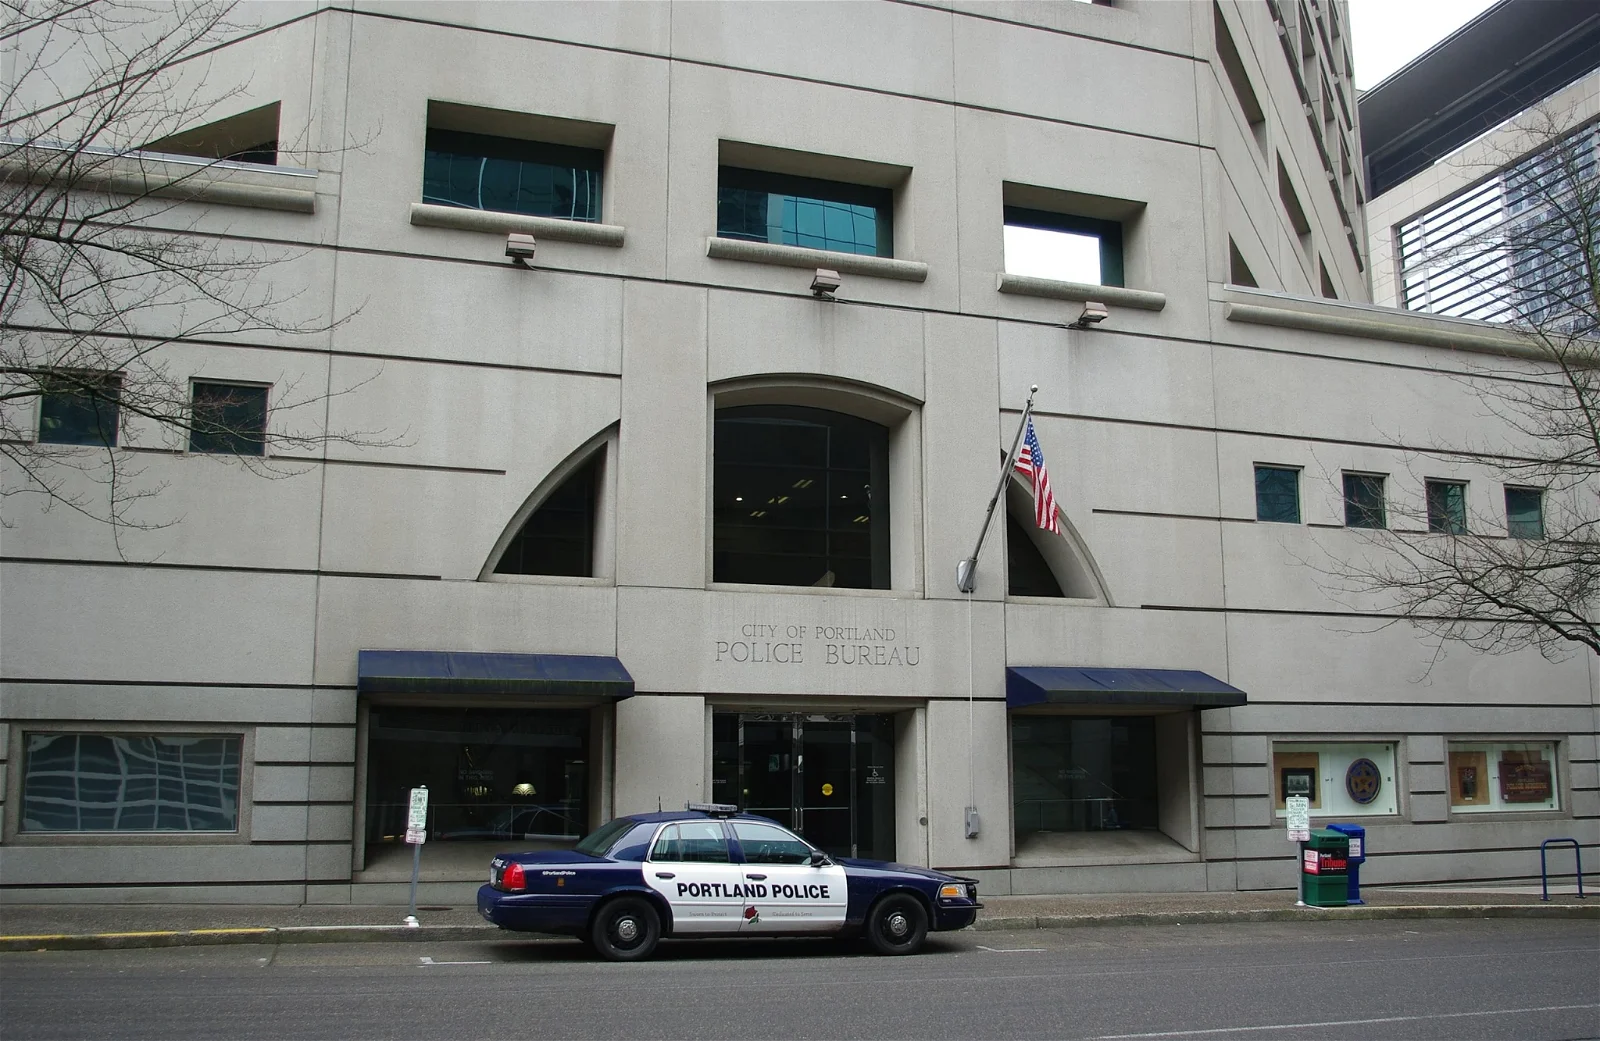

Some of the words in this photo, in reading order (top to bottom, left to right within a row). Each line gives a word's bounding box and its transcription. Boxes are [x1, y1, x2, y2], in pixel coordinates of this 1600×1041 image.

[741, 624, 778, 638] CITY
[786, 625, 807, 639] OF
[815, 626, 896, 641] PORTLAND
[715, 641, 804, 664] POLICE
[825, 644, 920, 666] BUREAU
[1321, 857, 1347, 868] Tribune
[677, 882, 767, 898] PORTLAND
[772, 884, 830, 899] POLICE
